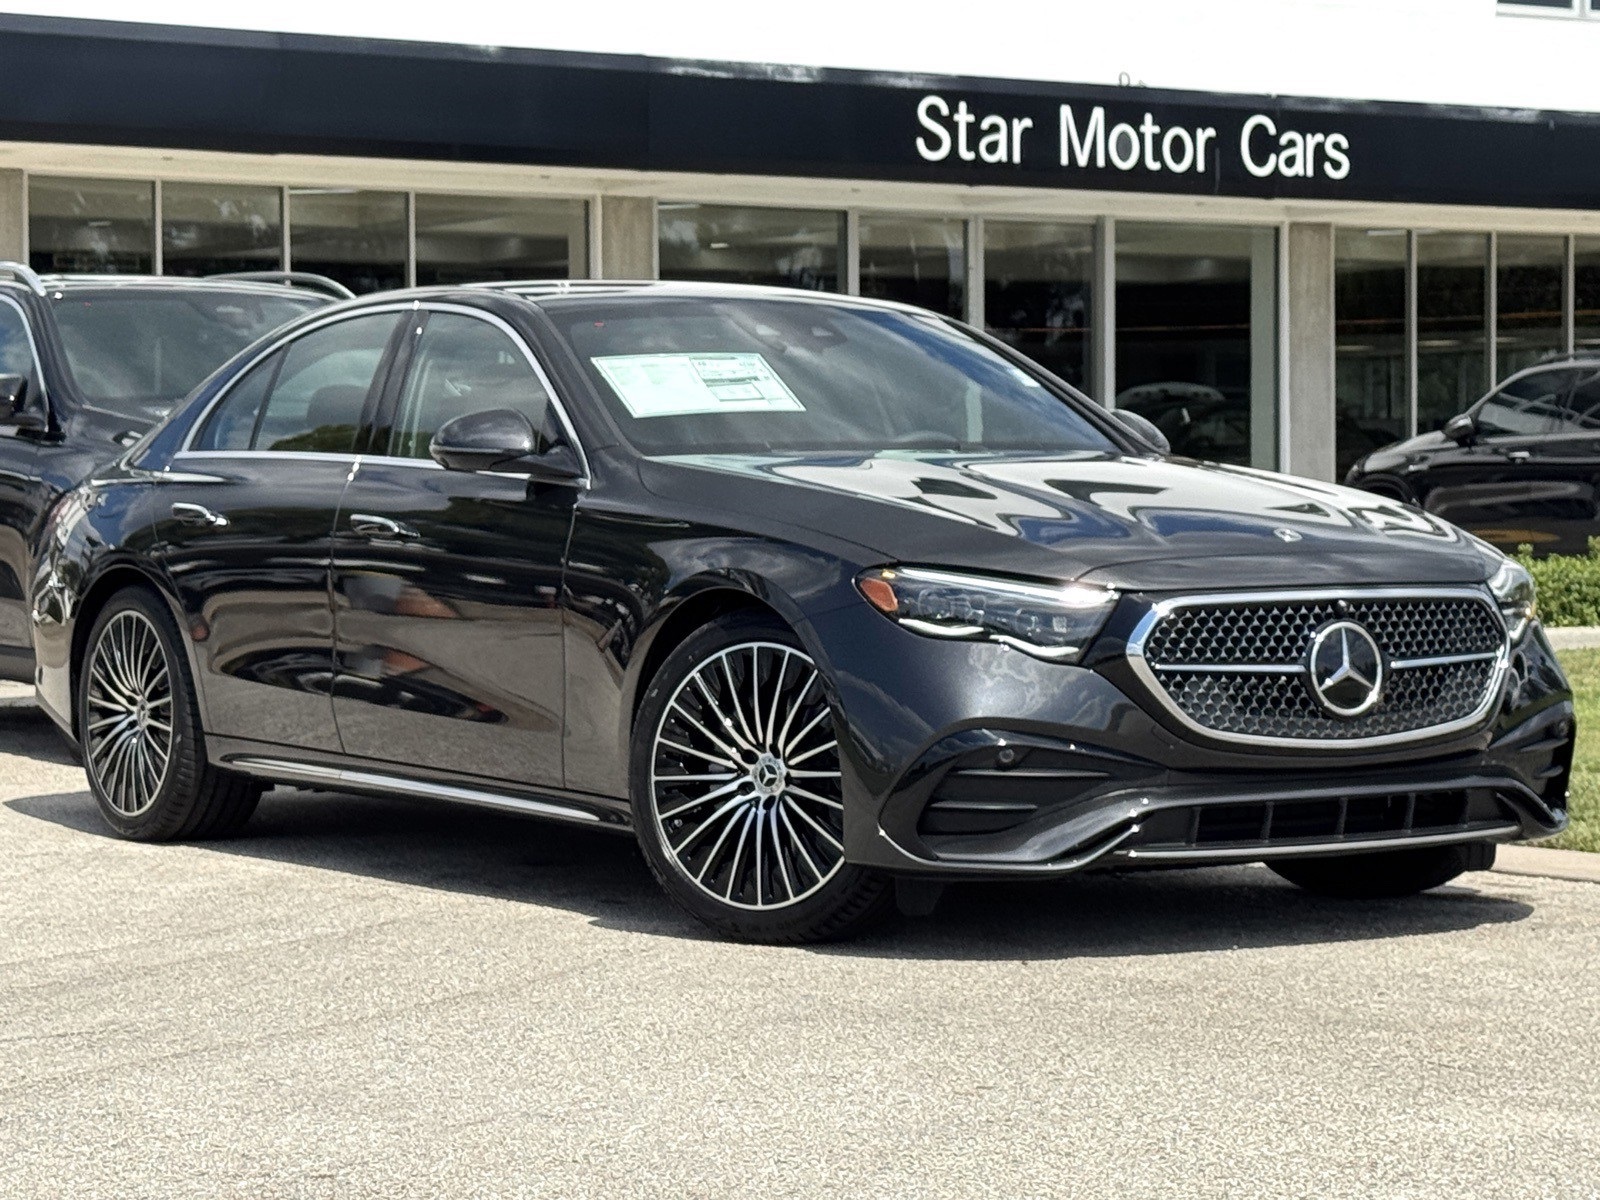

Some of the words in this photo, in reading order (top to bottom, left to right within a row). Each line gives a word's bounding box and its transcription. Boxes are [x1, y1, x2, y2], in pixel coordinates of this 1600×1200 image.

[915, 96, 1033, 164] Star
[1059, 104, 1217, 173] Motor
[1240, 114, 1351, 180] Cars
